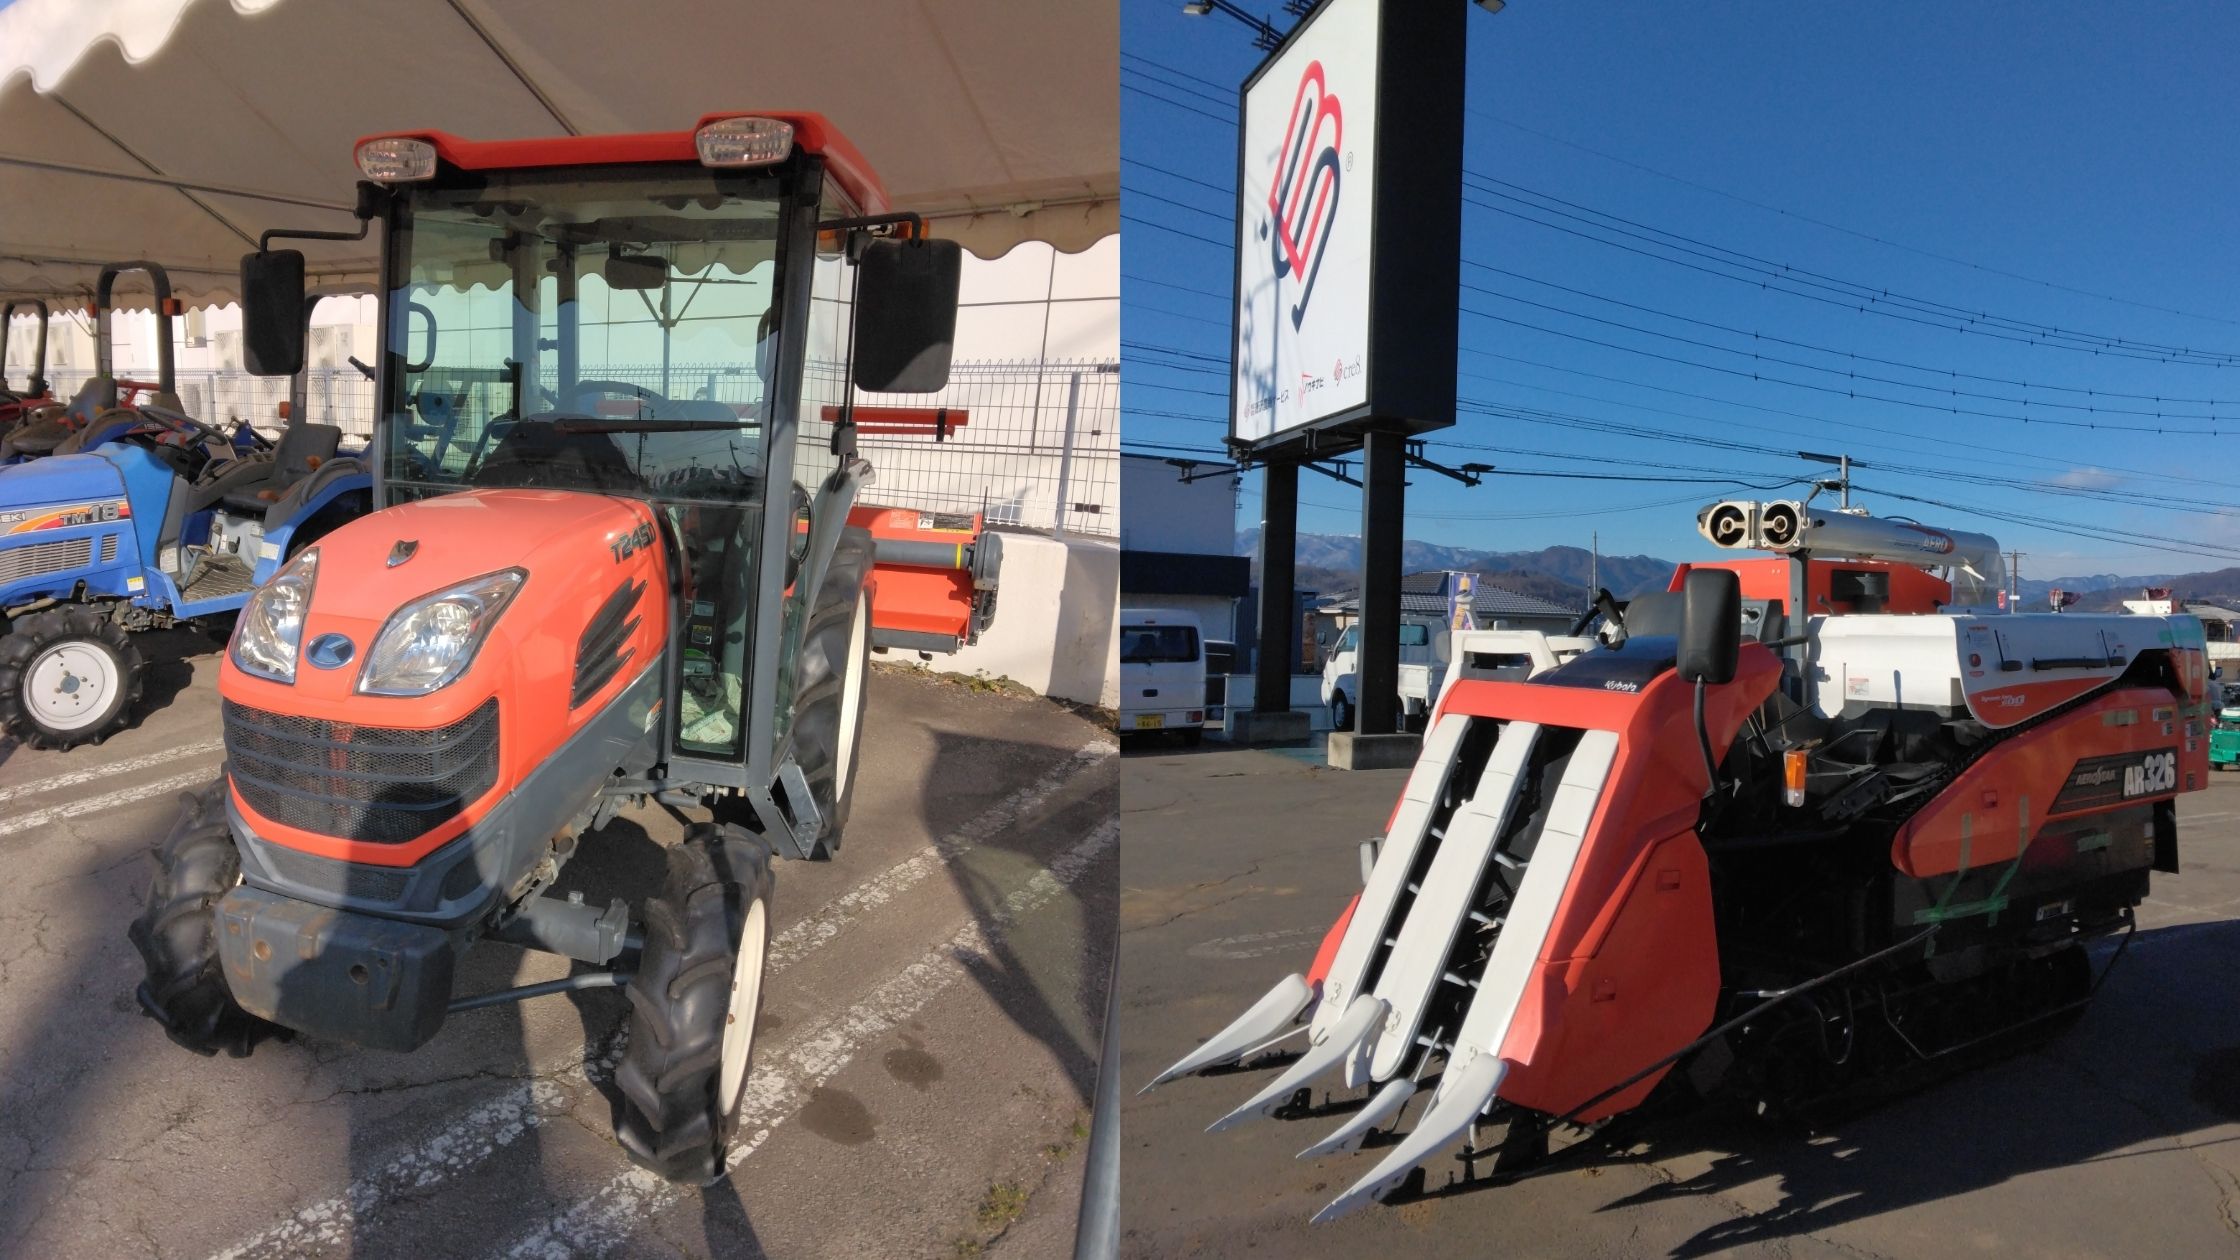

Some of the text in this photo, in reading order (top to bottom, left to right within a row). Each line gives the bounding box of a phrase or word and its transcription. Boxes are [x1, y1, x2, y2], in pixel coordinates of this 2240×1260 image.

[60, 503, 119, 525] TM18
[1604, 680, 1637, 692] Kubota
[2123, 752, 2176, 797] AR326
